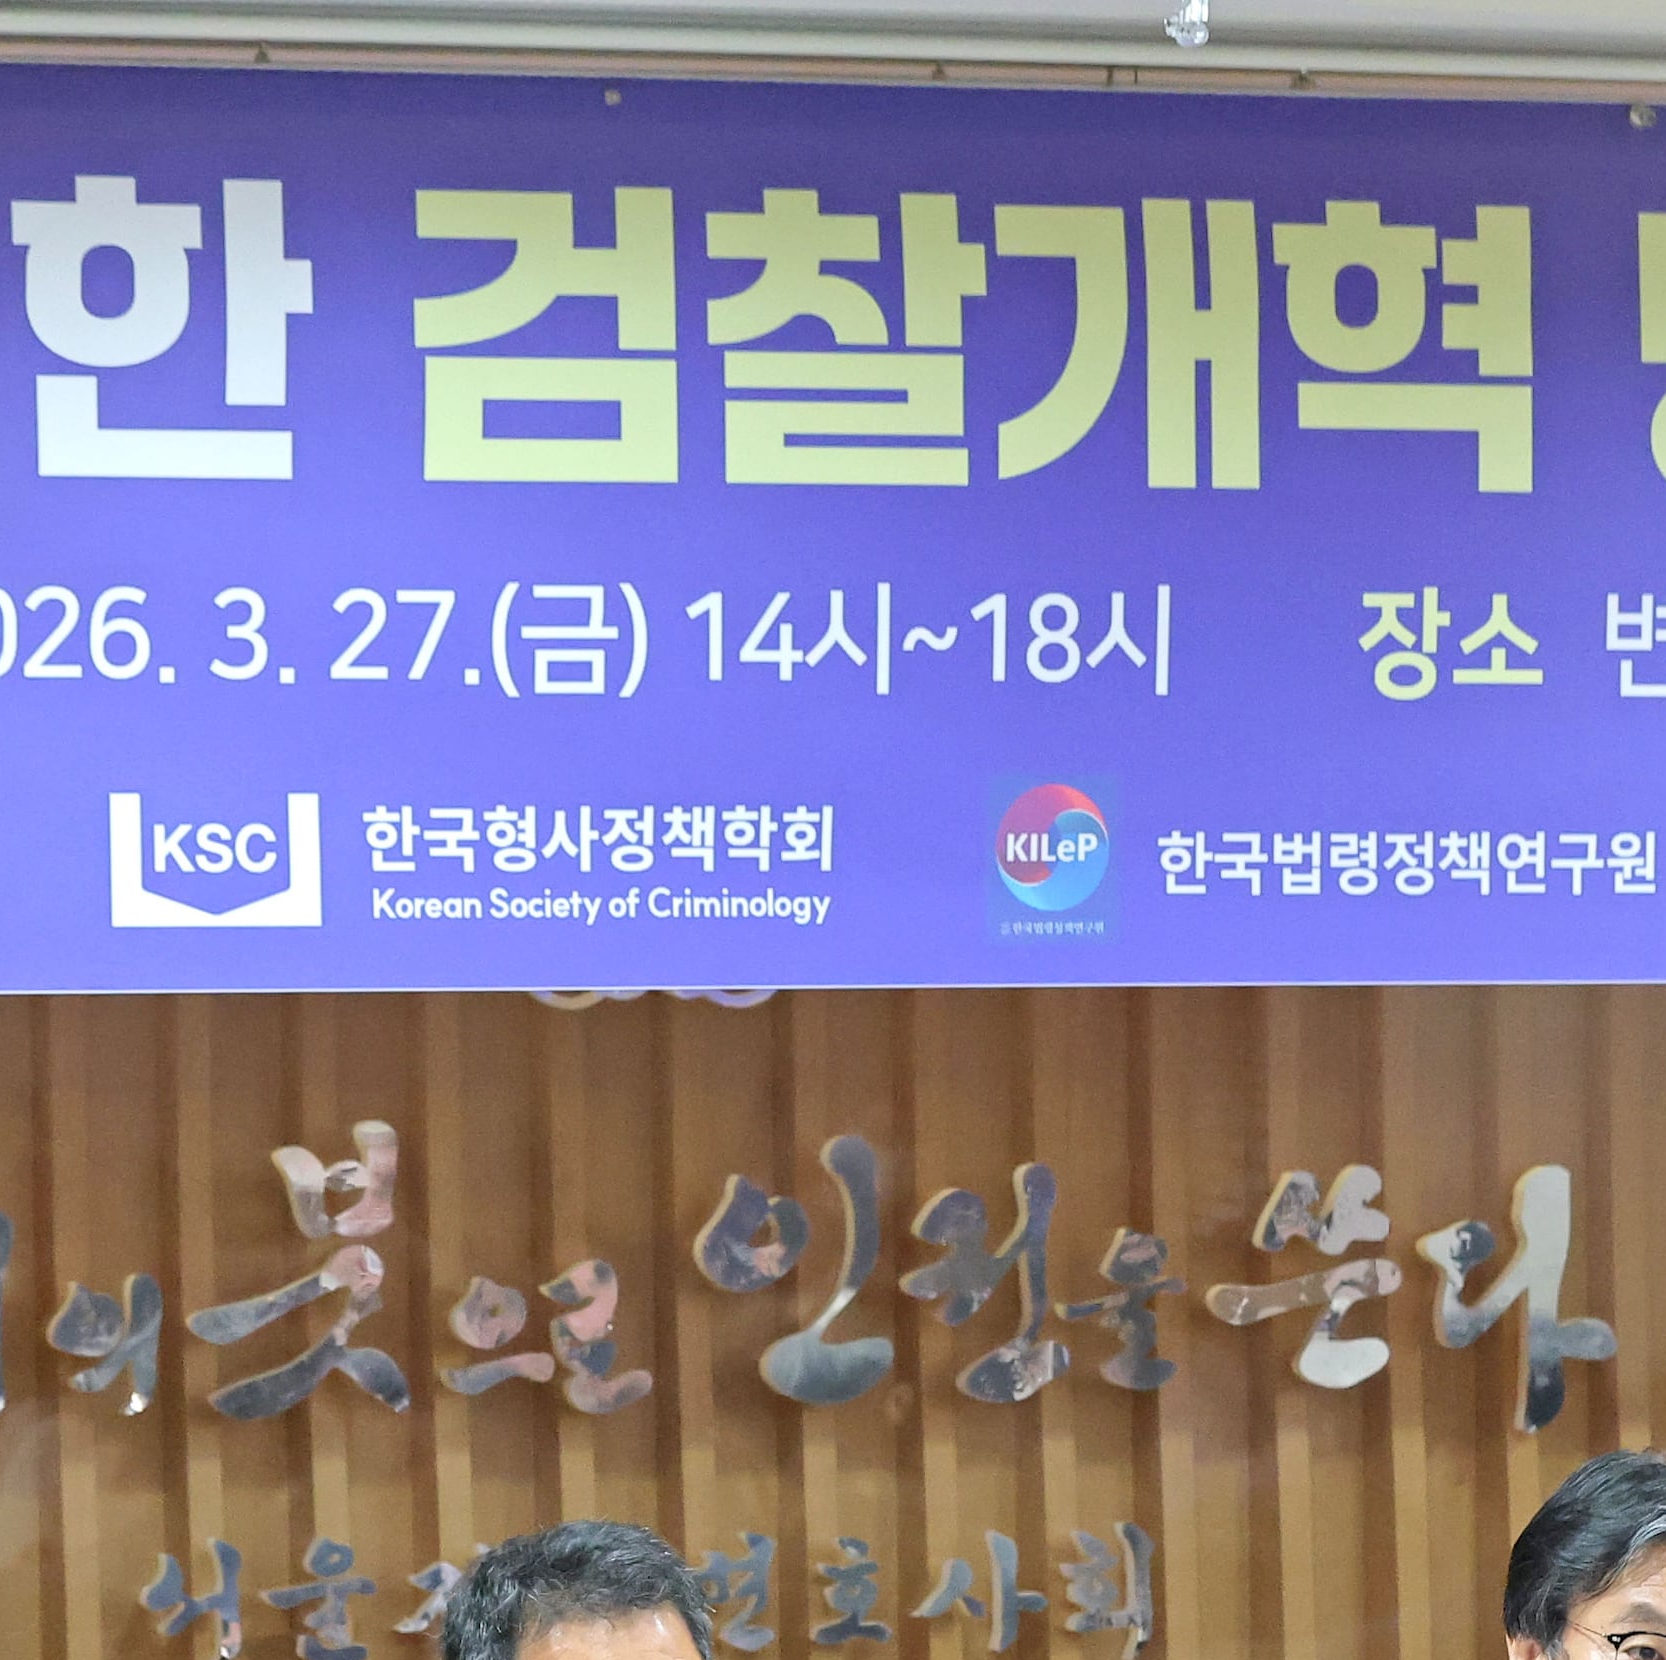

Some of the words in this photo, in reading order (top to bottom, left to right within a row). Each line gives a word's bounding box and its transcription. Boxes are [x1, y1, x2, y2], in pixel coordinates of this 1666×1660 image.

[414, 188, 1532, 493] 검찰개혁
[210, 588, 295, 683] 3.
[686, 583, 1170, 695] 14시~18시
[1359, 587, 1543, 700] 장소
[154, 823, 276, 873] KSC
[363, 805, 832, 872] 한국형사정책학회
[1007, 833, 1098, 863] KILeP
[1158, 831, 1655, 895] 한국법령정책연구원
[373, 889, 482, 918] Korean
[490, 888, 601, 925] Society
[609, 888, 639, 917] of
[648, 887, 830, 924] Criminology
